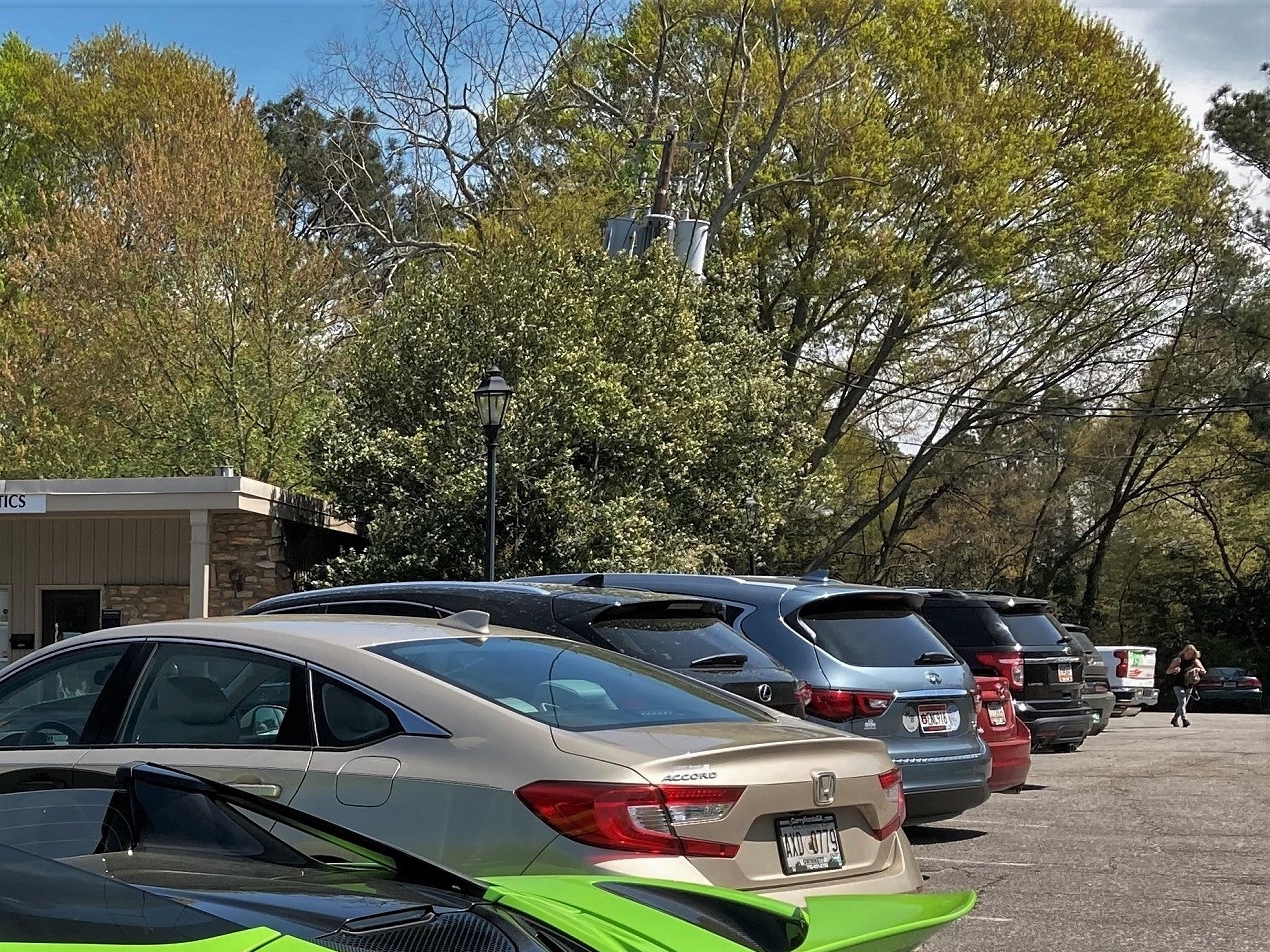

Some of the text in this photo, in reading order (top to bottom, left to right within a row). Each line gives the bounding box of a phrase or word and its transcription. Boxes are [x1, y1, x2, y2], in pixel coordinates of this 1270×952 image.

[661, 772, 717, 782] ACCORD
[784, 829, 838, 857] AXD 0779
